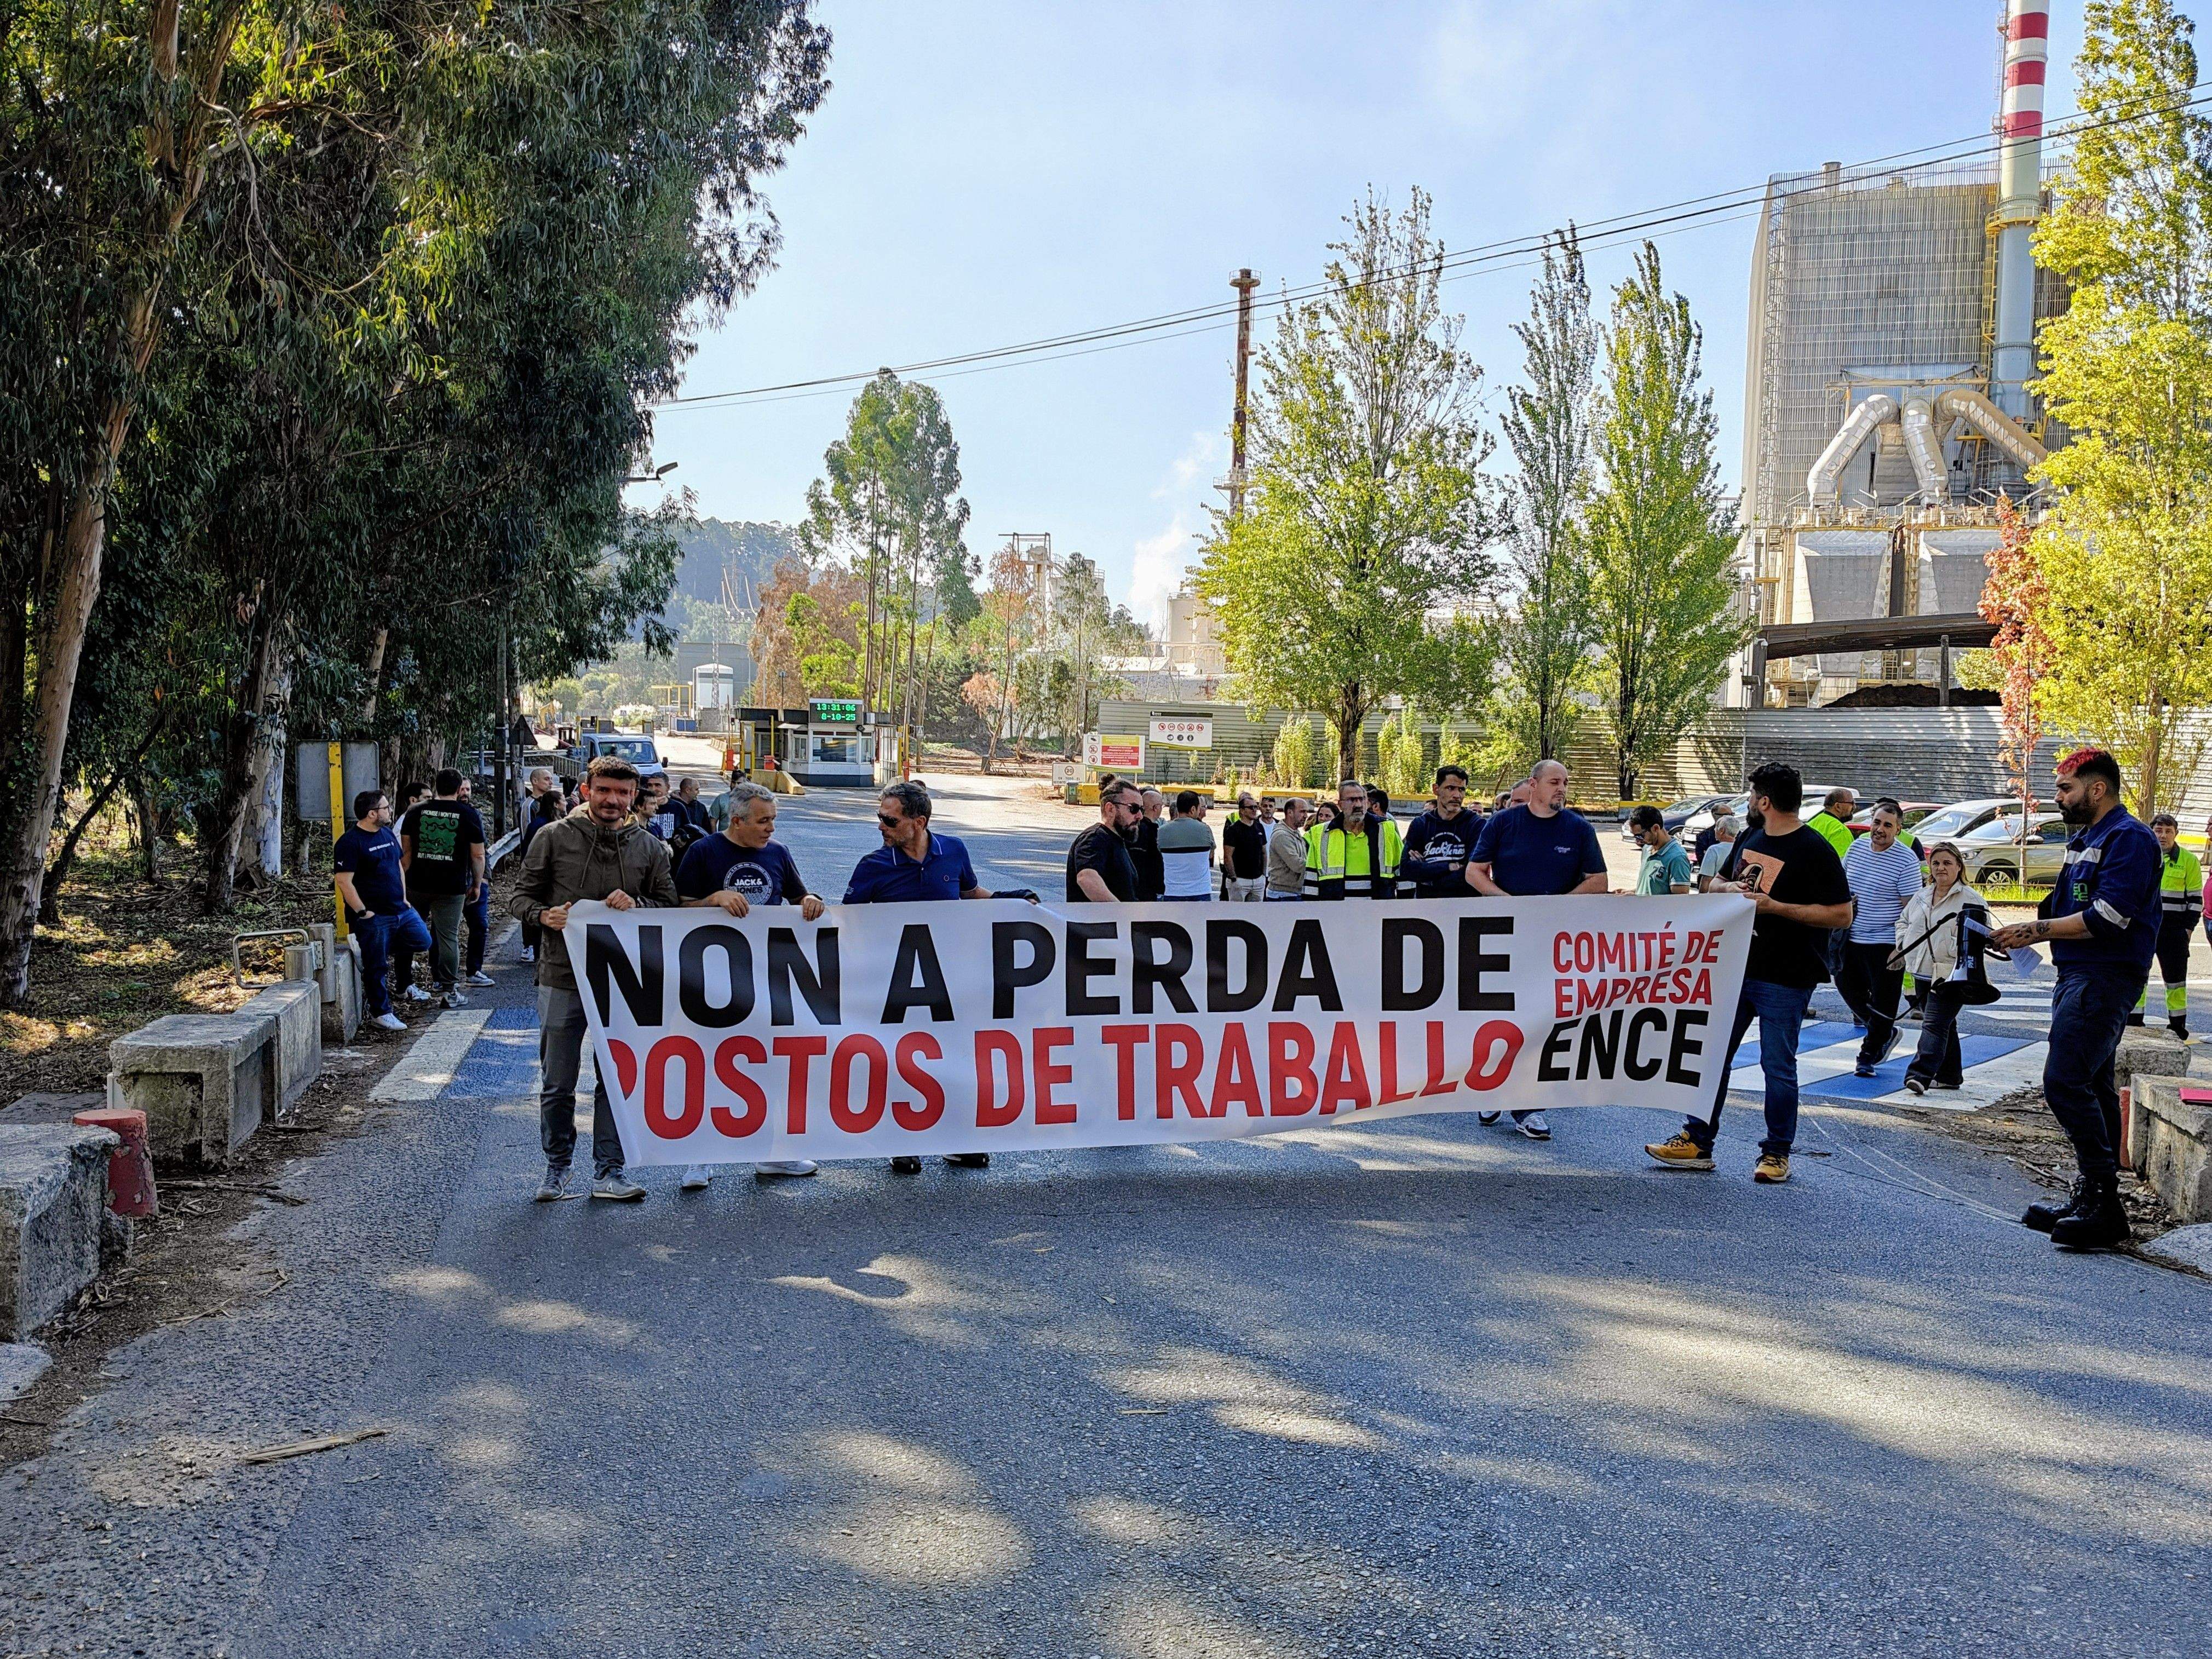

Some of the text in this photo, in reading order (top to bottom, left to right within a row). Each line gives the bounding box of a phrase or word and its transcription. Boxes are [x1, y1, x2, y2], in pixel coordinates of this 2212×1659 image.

[586, 916, 1515, 1027] NON A PERDA DE
[1553, 921, 1724, 973] COMITÉ DE
[1555, 968, 1713, 1018] EMPRESA
[974, 1026, 1077, 1127] DE
[1102, 1020, 1524, 1120] TRABALLO
[1537, 1007, 1709, 1087] ENCE
